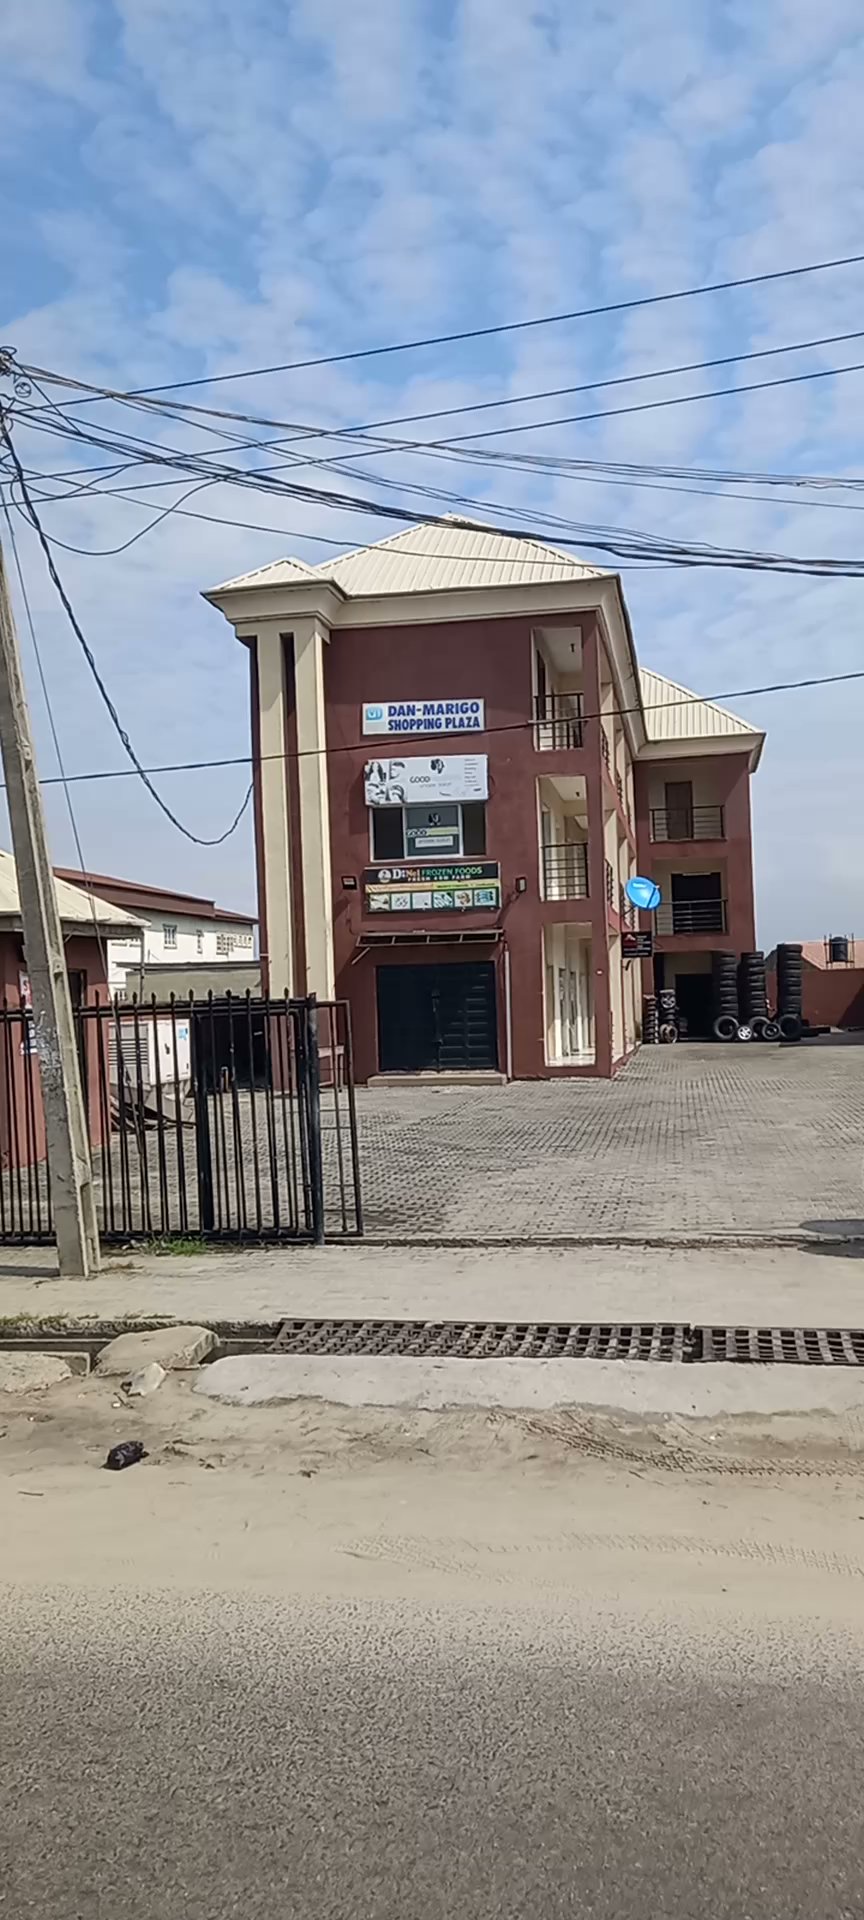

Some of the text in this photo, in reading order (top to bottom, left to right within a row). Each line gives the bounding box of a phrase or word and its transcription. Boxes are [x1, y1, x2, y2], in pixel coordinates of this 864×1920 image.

[388, 702, 480, 717] DAN-MARIGO
[388, 717, 480, 731] SHOPPING PLAZA
[422, 868, 453, 876] FROZEN
[454, 866, 482, 875] FOODS
